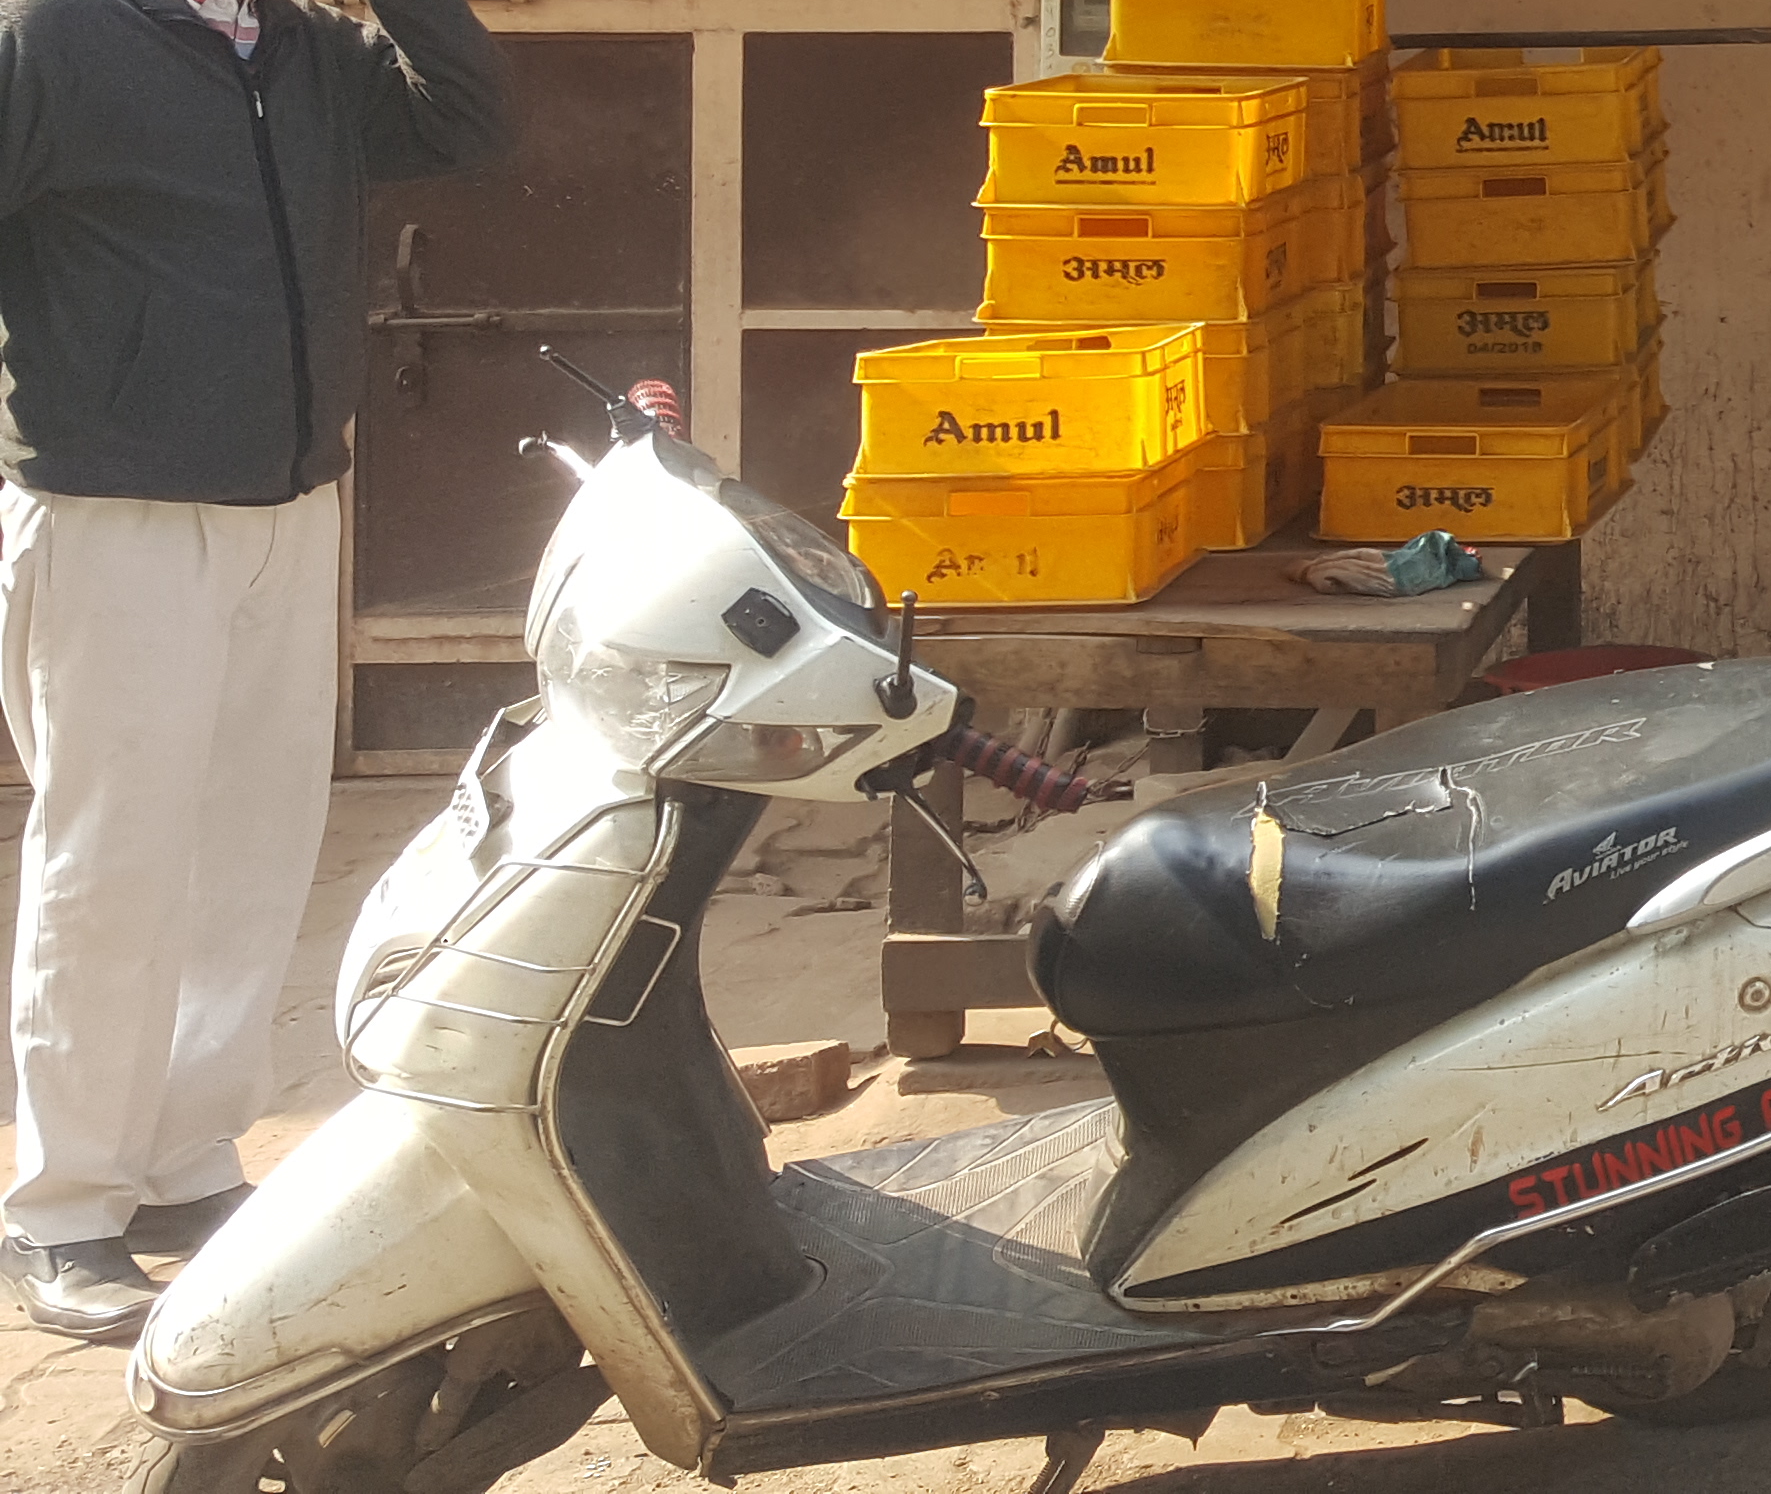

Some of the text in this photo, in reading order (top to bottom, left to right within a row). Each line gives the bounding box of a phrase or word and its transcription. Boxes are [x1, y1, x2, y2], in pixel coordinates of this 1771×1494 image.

[1456, 116, 1548, 148] Amul
[1055, 143, 1156, 177] Amul
[923, 408, 1062, 448] Amul
[1543, 825, 1679, 906] AVIATOR
[1508, 1104, 1744, 1221] STUNNING
